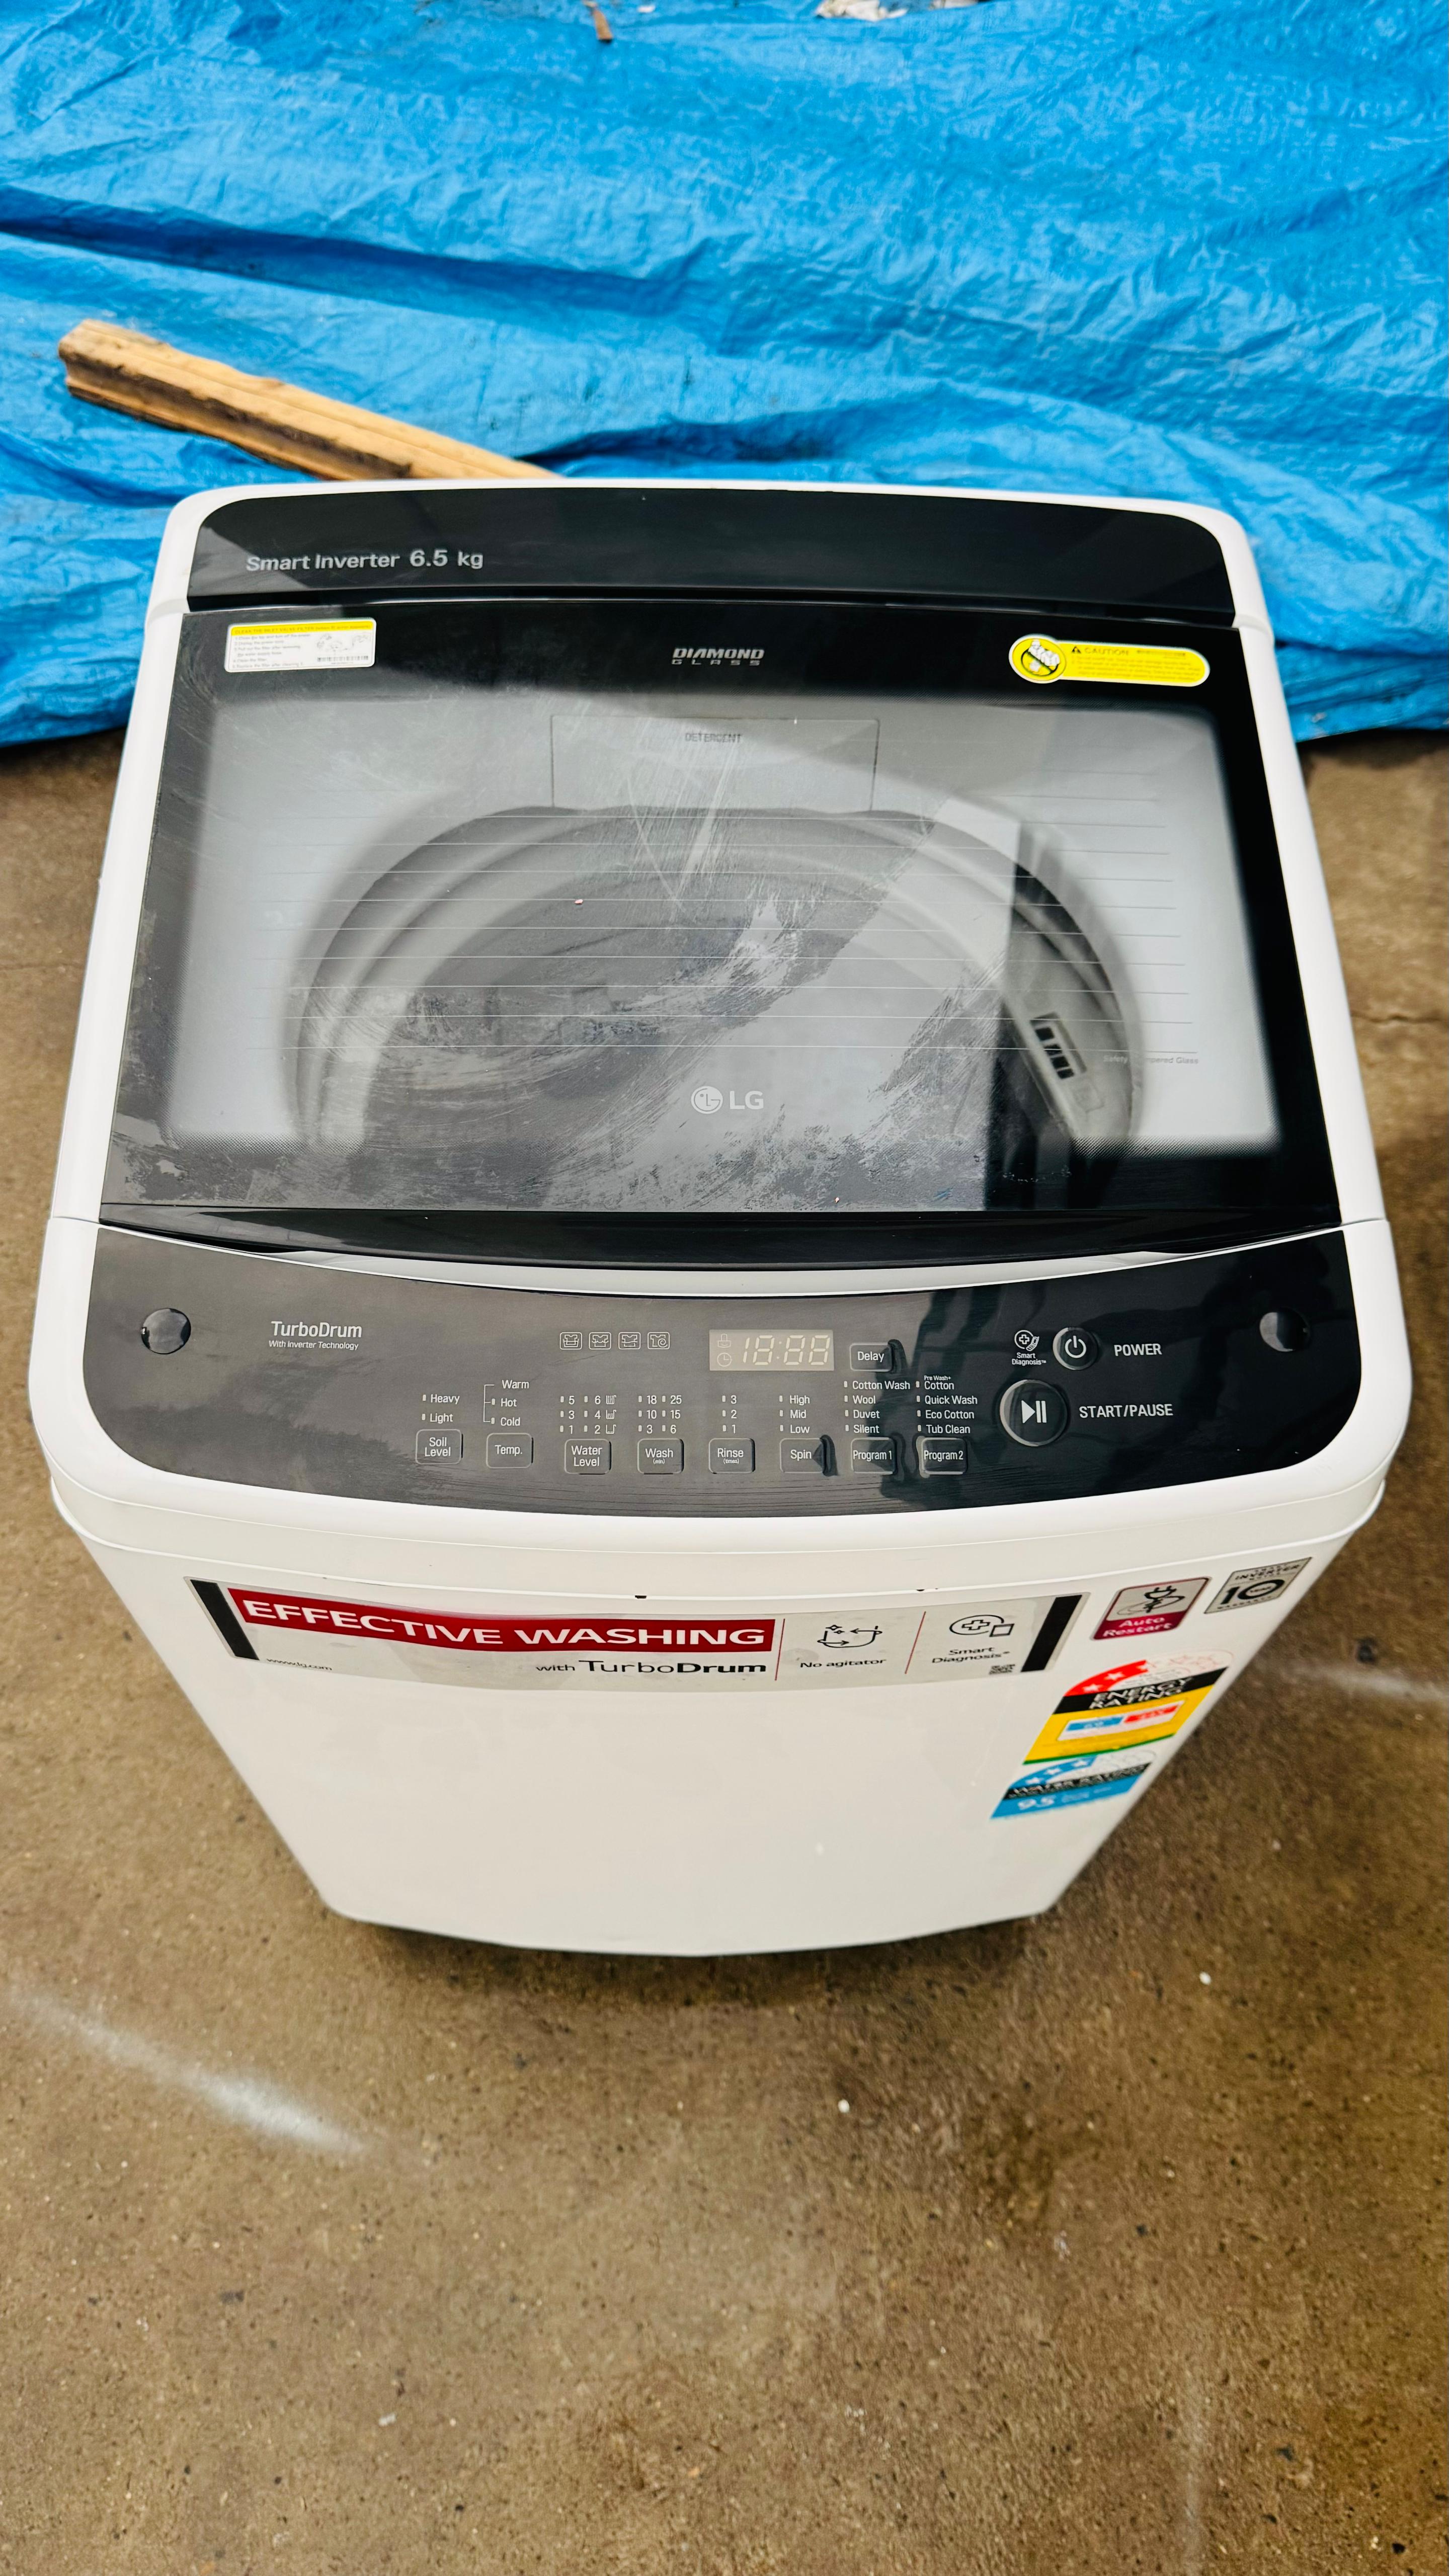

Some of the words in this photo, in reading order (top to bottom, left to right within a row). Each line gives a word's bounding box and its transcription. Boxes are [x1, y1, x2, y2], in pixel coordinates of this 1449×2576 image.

[246, 556, 310, 572] Smart
[315, 553, 400, 570] Inverter
[410, 550, 448, 567] 6.5
[458, 551, 483, 570] kg
[672, 648, 764, 660] DIAMOND
[1084, 647, 1129, 657] CAUTION
[685, 733, 743, 744] DETERGENT
[1103, 1055, 1129, 1064] Safety
[730, 1090, 764, 1110] LG
[271, 1321, 362, 1338] TurboDrum
[269, 1340, 286, 1348] With
[287, 1340, 316, 1349] Inverter
[318, 1341, 359, 1350] Technology
[1113, 1343, 1162, 1356] POWER
[857, 1351, 884, 1362] Delay
[502, 1380, 529, 1389] Warm
[852, 1381, 882, 1390] Cotton
[885, 1381, 910, 1390] Wash
[924, 1381, 954, 1390] Cotton
[431, 1394, 460, 1405] Heavy
[501, 1398, 517, 1407] Hot
[569, 1396, 575, 1405] 5
[594, 1395, 601, 1405] 6
[647, 1395, 657, 1405] 18
[670, 1395, 682, 1405] 25
[731, 1395, 737, 1405] 3
[790, 1395, 810, 1406] High
[852, 1395, 876, 1404] Wool
[925, 1395, 949, 1405] Quick
[952, 1395, 978, 1404] Wash
[569, 1410, 575, 1419] 3
[594, 1410, 601, 1419] 4
[647, 1410, 657, 1419] 10
[670, 1410, 681, 1419] 15
[731, 1410, 737, 1419] 2
[790, 1410, 807, 1419] Mid
[853, 1410, 880, 1419] Duvet
[925, 1410, 942, 1419] Eco
[944, 1410, 975, 1419] Cotton
[1079, 1403, 1174, 1419] START/PAUSE
[430, 1413, 453, 1424] Light
[500, 1417, 521, 1426] Cold
[569, 1425, 573, 1434] 1
[594, 1425, 601, 1434] 2
[647, 1425, 653, 1434] 3
[670, 1424, 677, 1434] 6
[732, 1424, 736, 1433] 1
[790, 1424, 810, 1434] Low
[853, 1424, 879, 1434] Silent
[926, 1424, 943, 1434] Tub
[945, 1424, 971, 1434] Clean
[429, 1437, 447, 1447] Soil
[425, 1447, 451, 1457] Level
[495, 1444, 523, 1456] Temp.
[572, 1445, 602, 1455] Water
[645, 1448, 673, 1458] Wash
[717, 1448, 744, 1458] Rinse
[790, 1450, 812, 1461] Spin
[853, 1450, 887, 1462] Program
[574, 1457, 599, 1467] Level
[1220, 1579, 1285, 1605] 10
[243, 1599, 503, 1645] EFFECTIVE
[514, 1628, 765, 1645] WASHING
[1118, 1616, 1166, 1628] Auto
[1103, 1622, 1173, 1637] Restart
[948, 1647, 995, 1656] Smart
[266, 1658, 333, 1670] www.lg.com
[578, 1660, 767, 1674] TurboDrum
[826, 1658, 887, 1668] agitator
[1093, 1676, 1193, 1702] ENERGY
